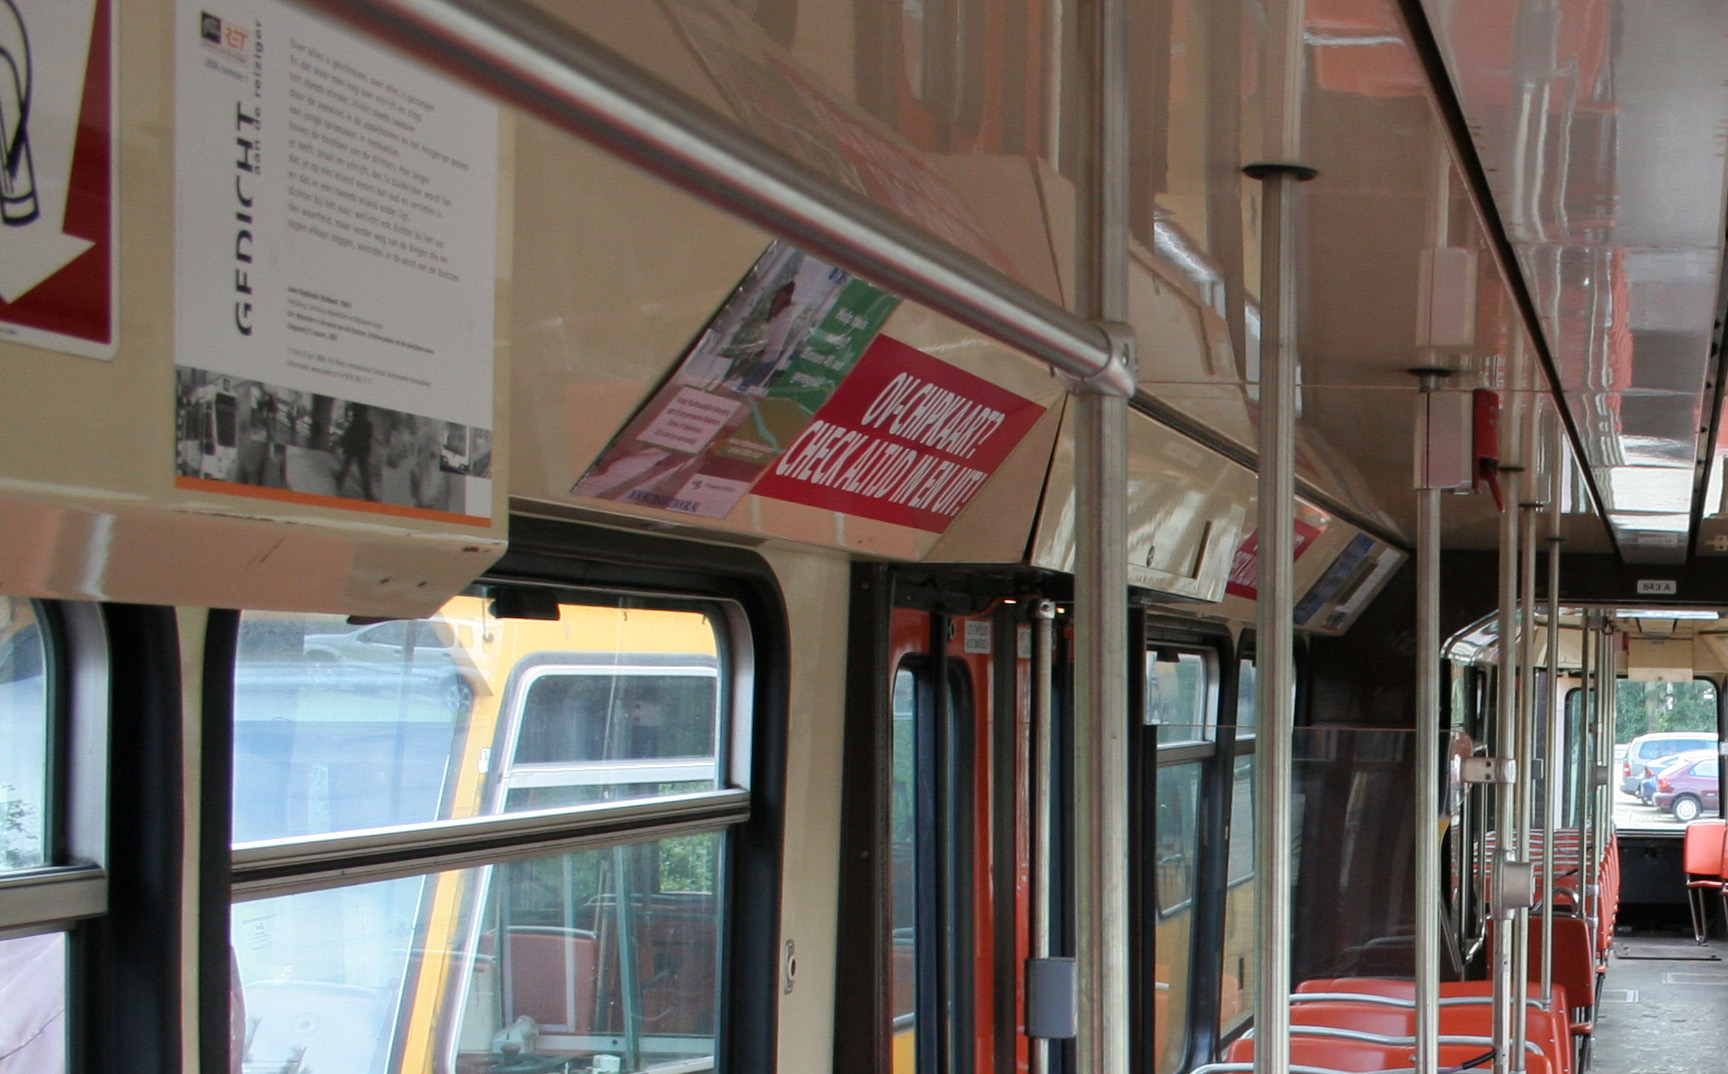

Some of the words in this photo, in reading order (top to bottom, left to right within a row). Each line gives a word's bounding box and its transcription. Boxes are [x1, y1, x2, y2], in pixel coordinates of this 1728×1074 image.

[253, 140, 261, 175] aan
[235, 101, 259, 337] GEDICHT
[861, 372, 1005, 459] OV-CHIPKAART?
[776, 420, 869, 486] CHECK
[833, 438, 918, 498] ALTIJD
[888, 454, 939, 504] IN
[908, 460, 960, 509] EN
[931, 466, 988, 517] UIT!
